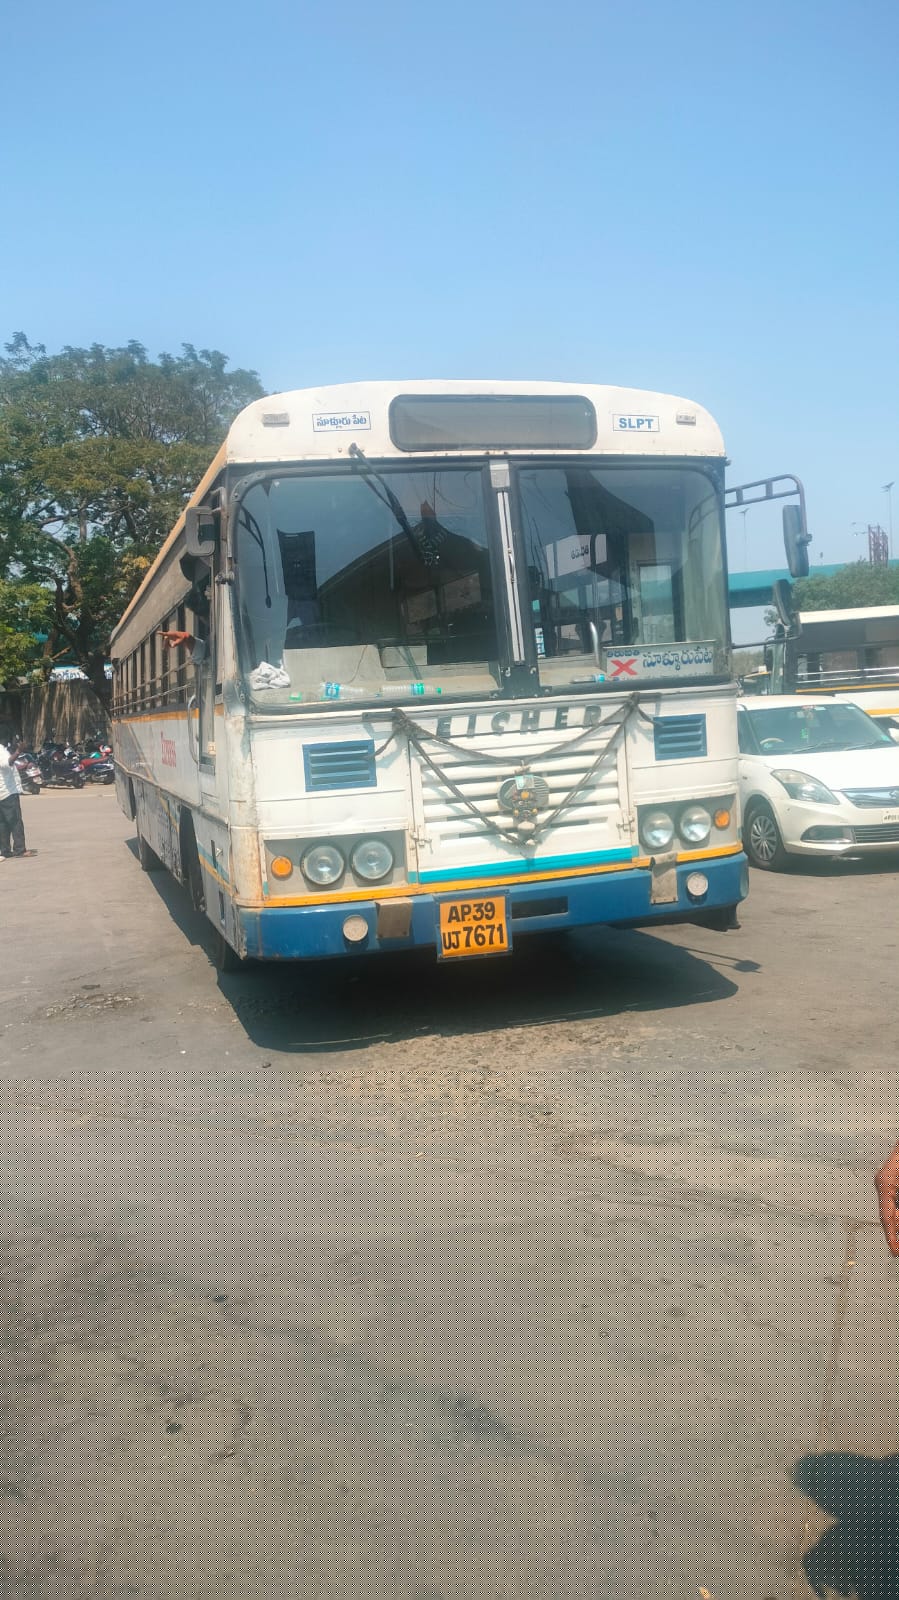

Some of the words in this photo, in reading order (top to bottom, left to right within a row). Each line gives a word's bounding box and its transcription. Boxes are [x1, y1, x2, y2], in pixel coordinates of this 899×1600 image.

[619, 417, 654, 429] SLPT
[436, 705, 601, 738] EICHER
[442, 931, 461, 950] UJ
[463, 923, 504, 948] 7671
